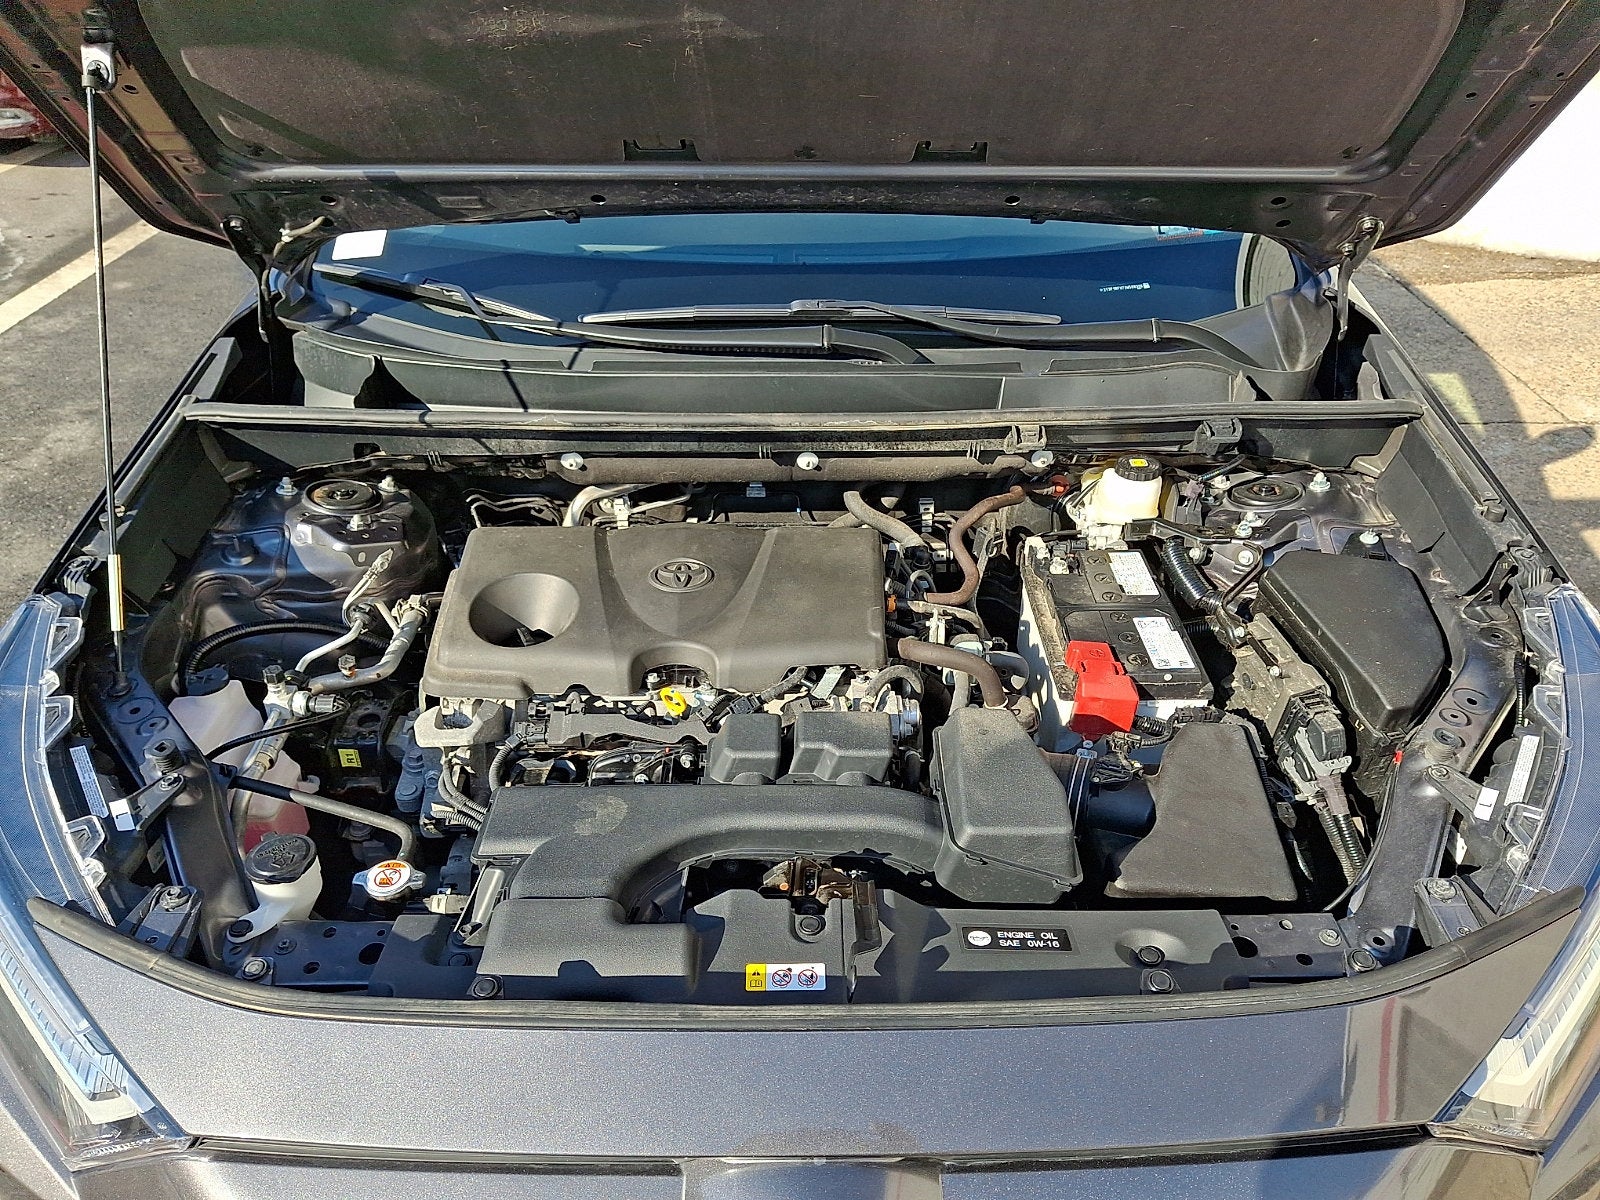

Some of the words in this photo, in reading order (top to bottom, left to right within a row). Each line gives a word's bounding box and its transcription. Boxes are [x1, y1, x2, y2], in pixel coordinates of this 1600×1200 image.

[997, 931, 1036, 939] ENGINE
[1040, 931, 1059, 940] OIL
[998, 940, 1021, 948] SAE
[1027, 940, 1060, 948] 0W-16
